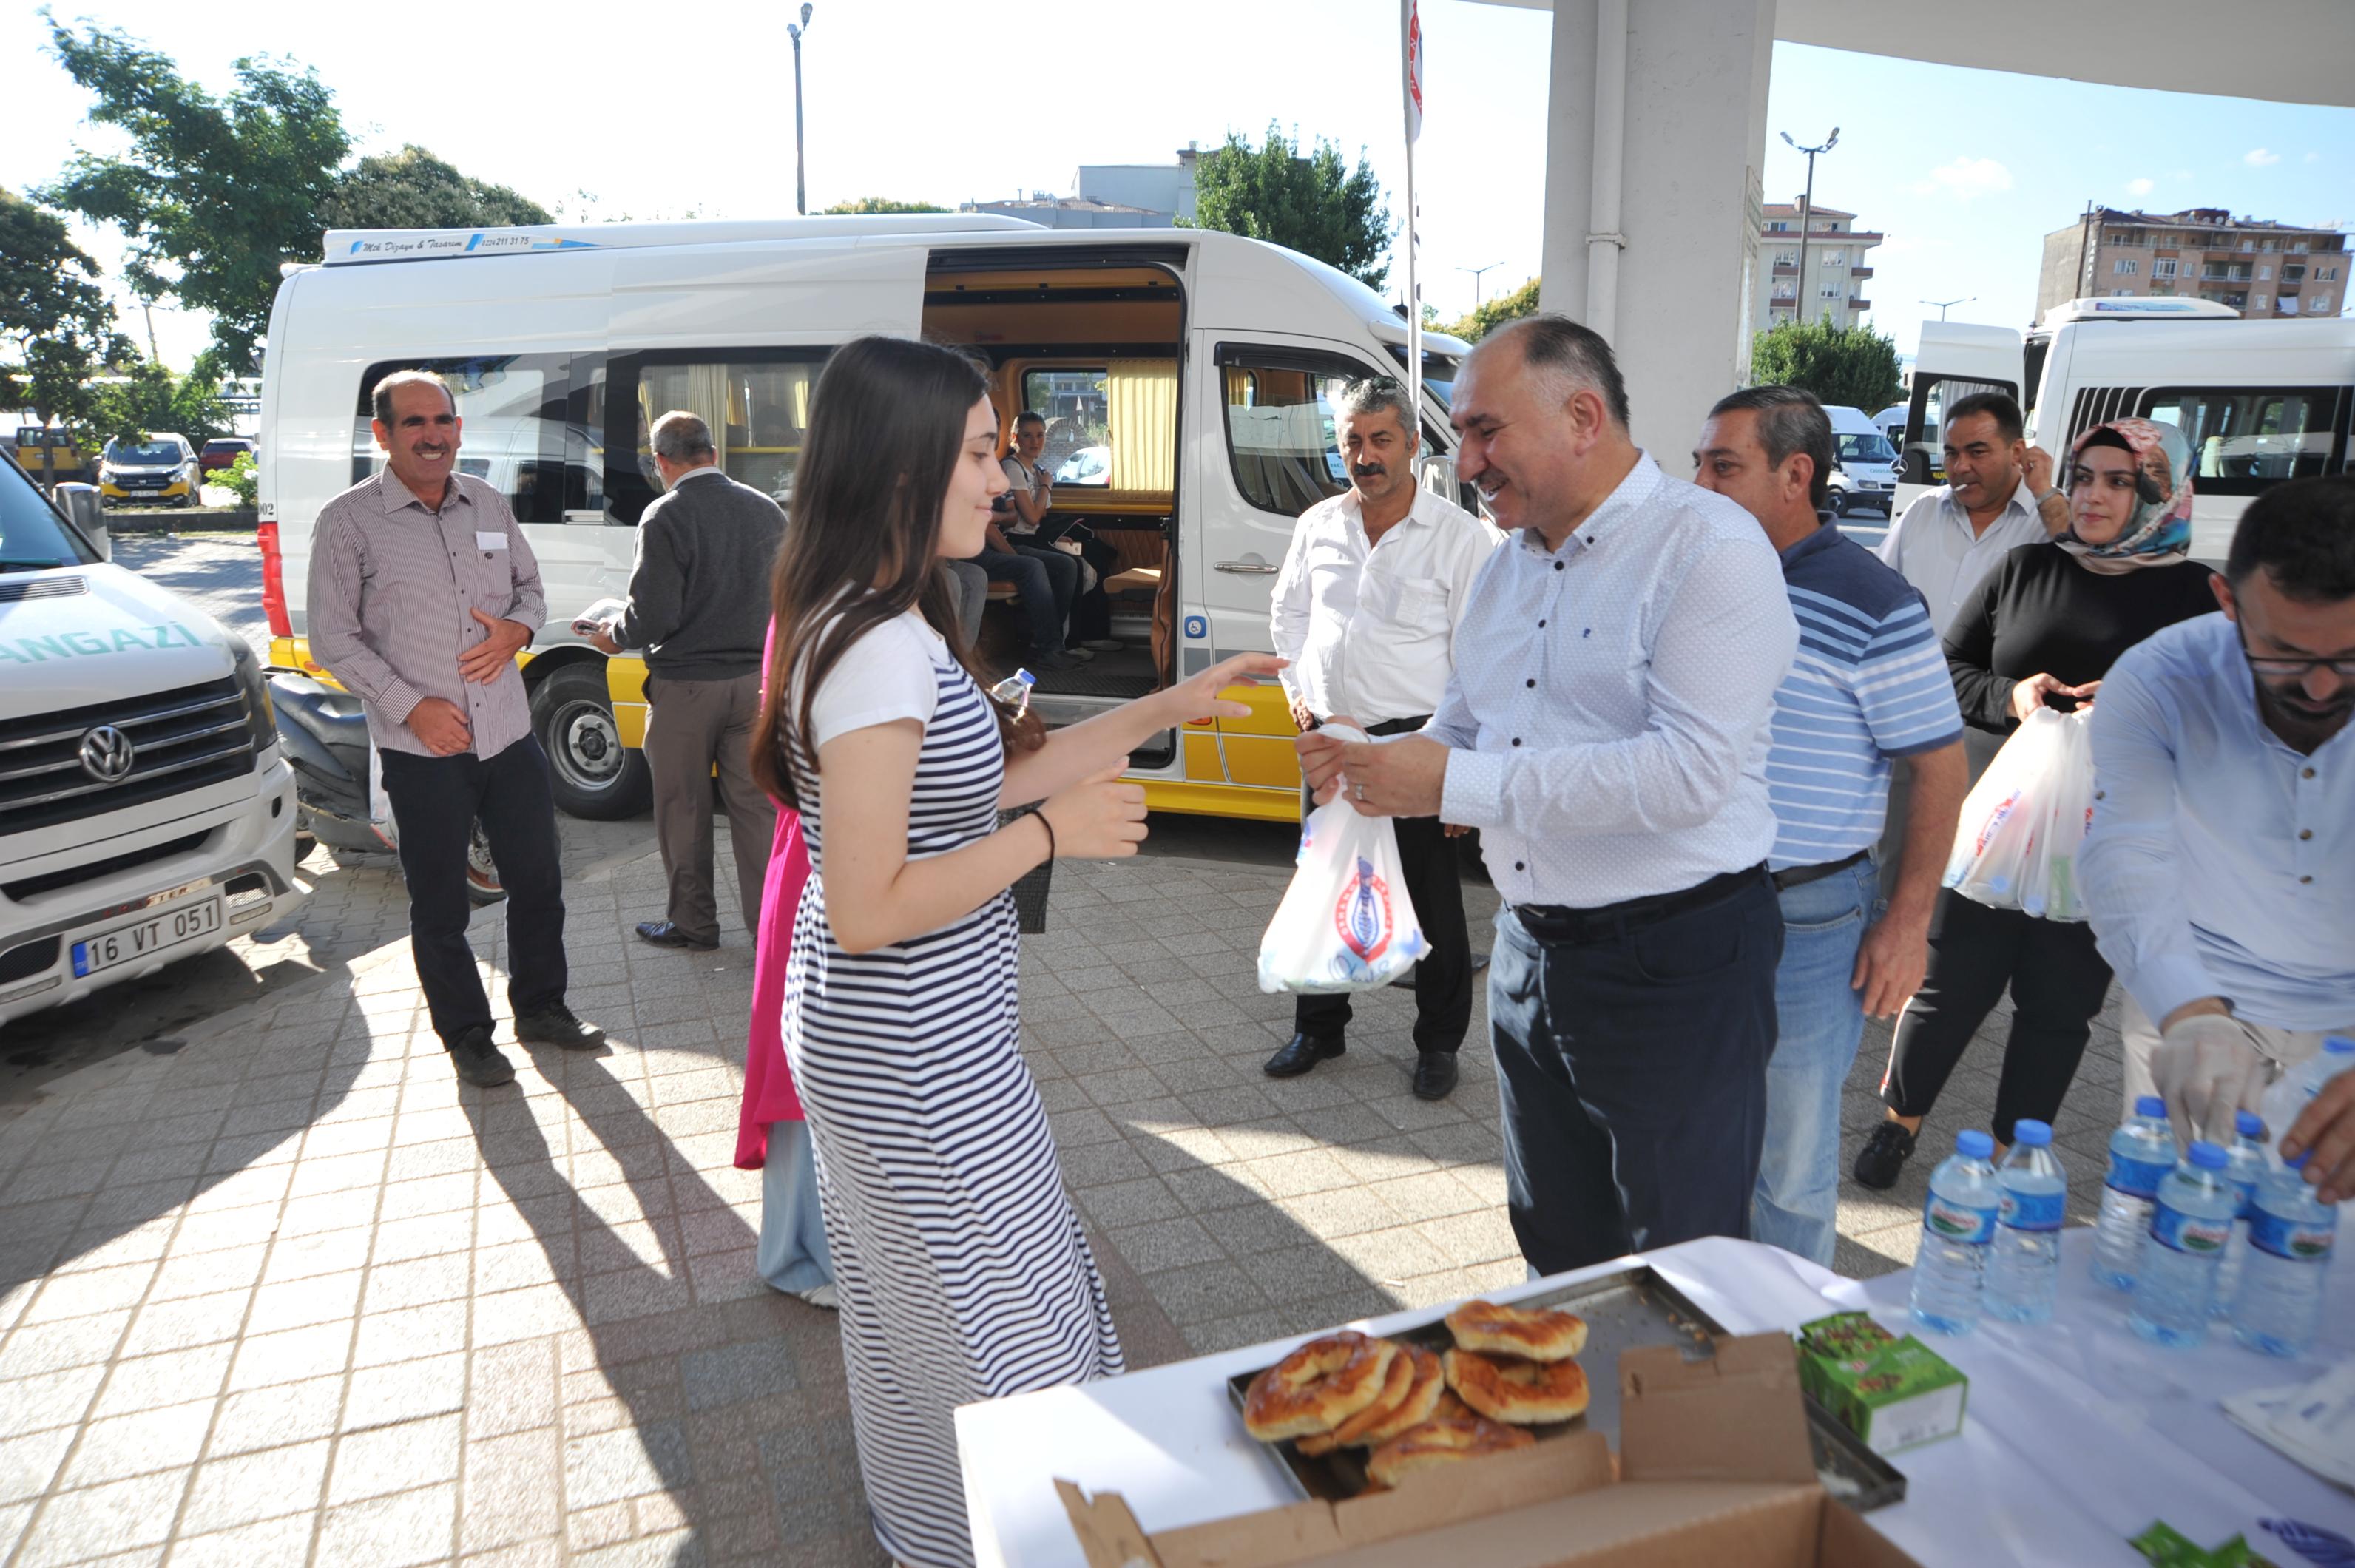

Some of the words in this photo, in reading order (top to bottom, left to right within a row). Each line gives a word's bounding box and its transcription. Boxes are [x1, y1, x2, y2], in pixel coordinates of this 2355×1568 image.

[385, 241, 413, 253] Dizayn
[417, 240, 425, 249] &
[510, 237, 518, 246] 31
[520, 236, 530, 245] 75
[91, 937, 118, 966] 16
[133, 922, 160, 951] VT
[175, 905, 214, 937] 051
